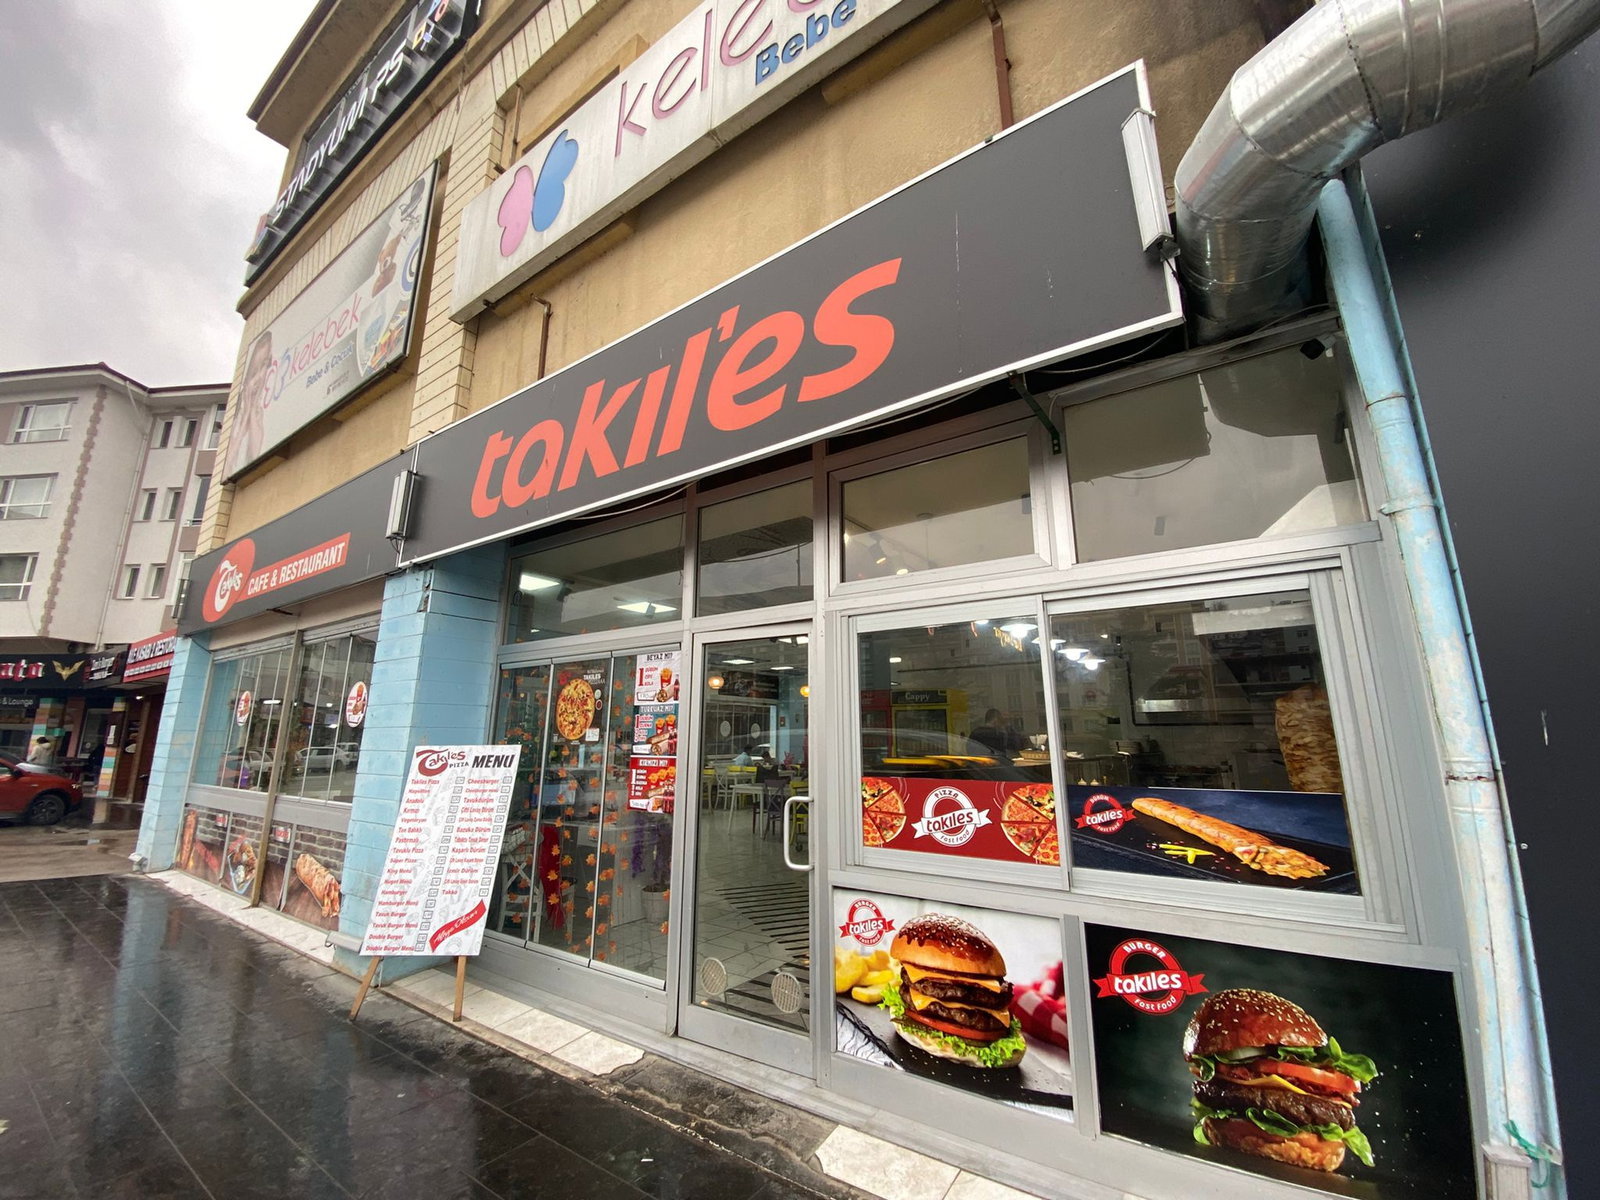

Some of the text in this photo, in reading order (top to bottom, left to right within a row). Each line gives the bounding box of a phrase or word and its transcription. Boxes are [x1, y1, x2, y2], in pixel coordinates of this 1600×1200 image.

[754, 0, 858, 86] Bebe
[289, 293, 362, 377] kelebek
[247, 572, 270, 595] CAFE
[270, 569, 278, 587] &
[278, 542, 346, 584] RESTAURANT
[9, 697, 33, 707] Lounge
[905, 692, 930, 702] Cappy
[471, 754, 515, 769] MENU
[1122, 940, 1167, 959] BURGER
